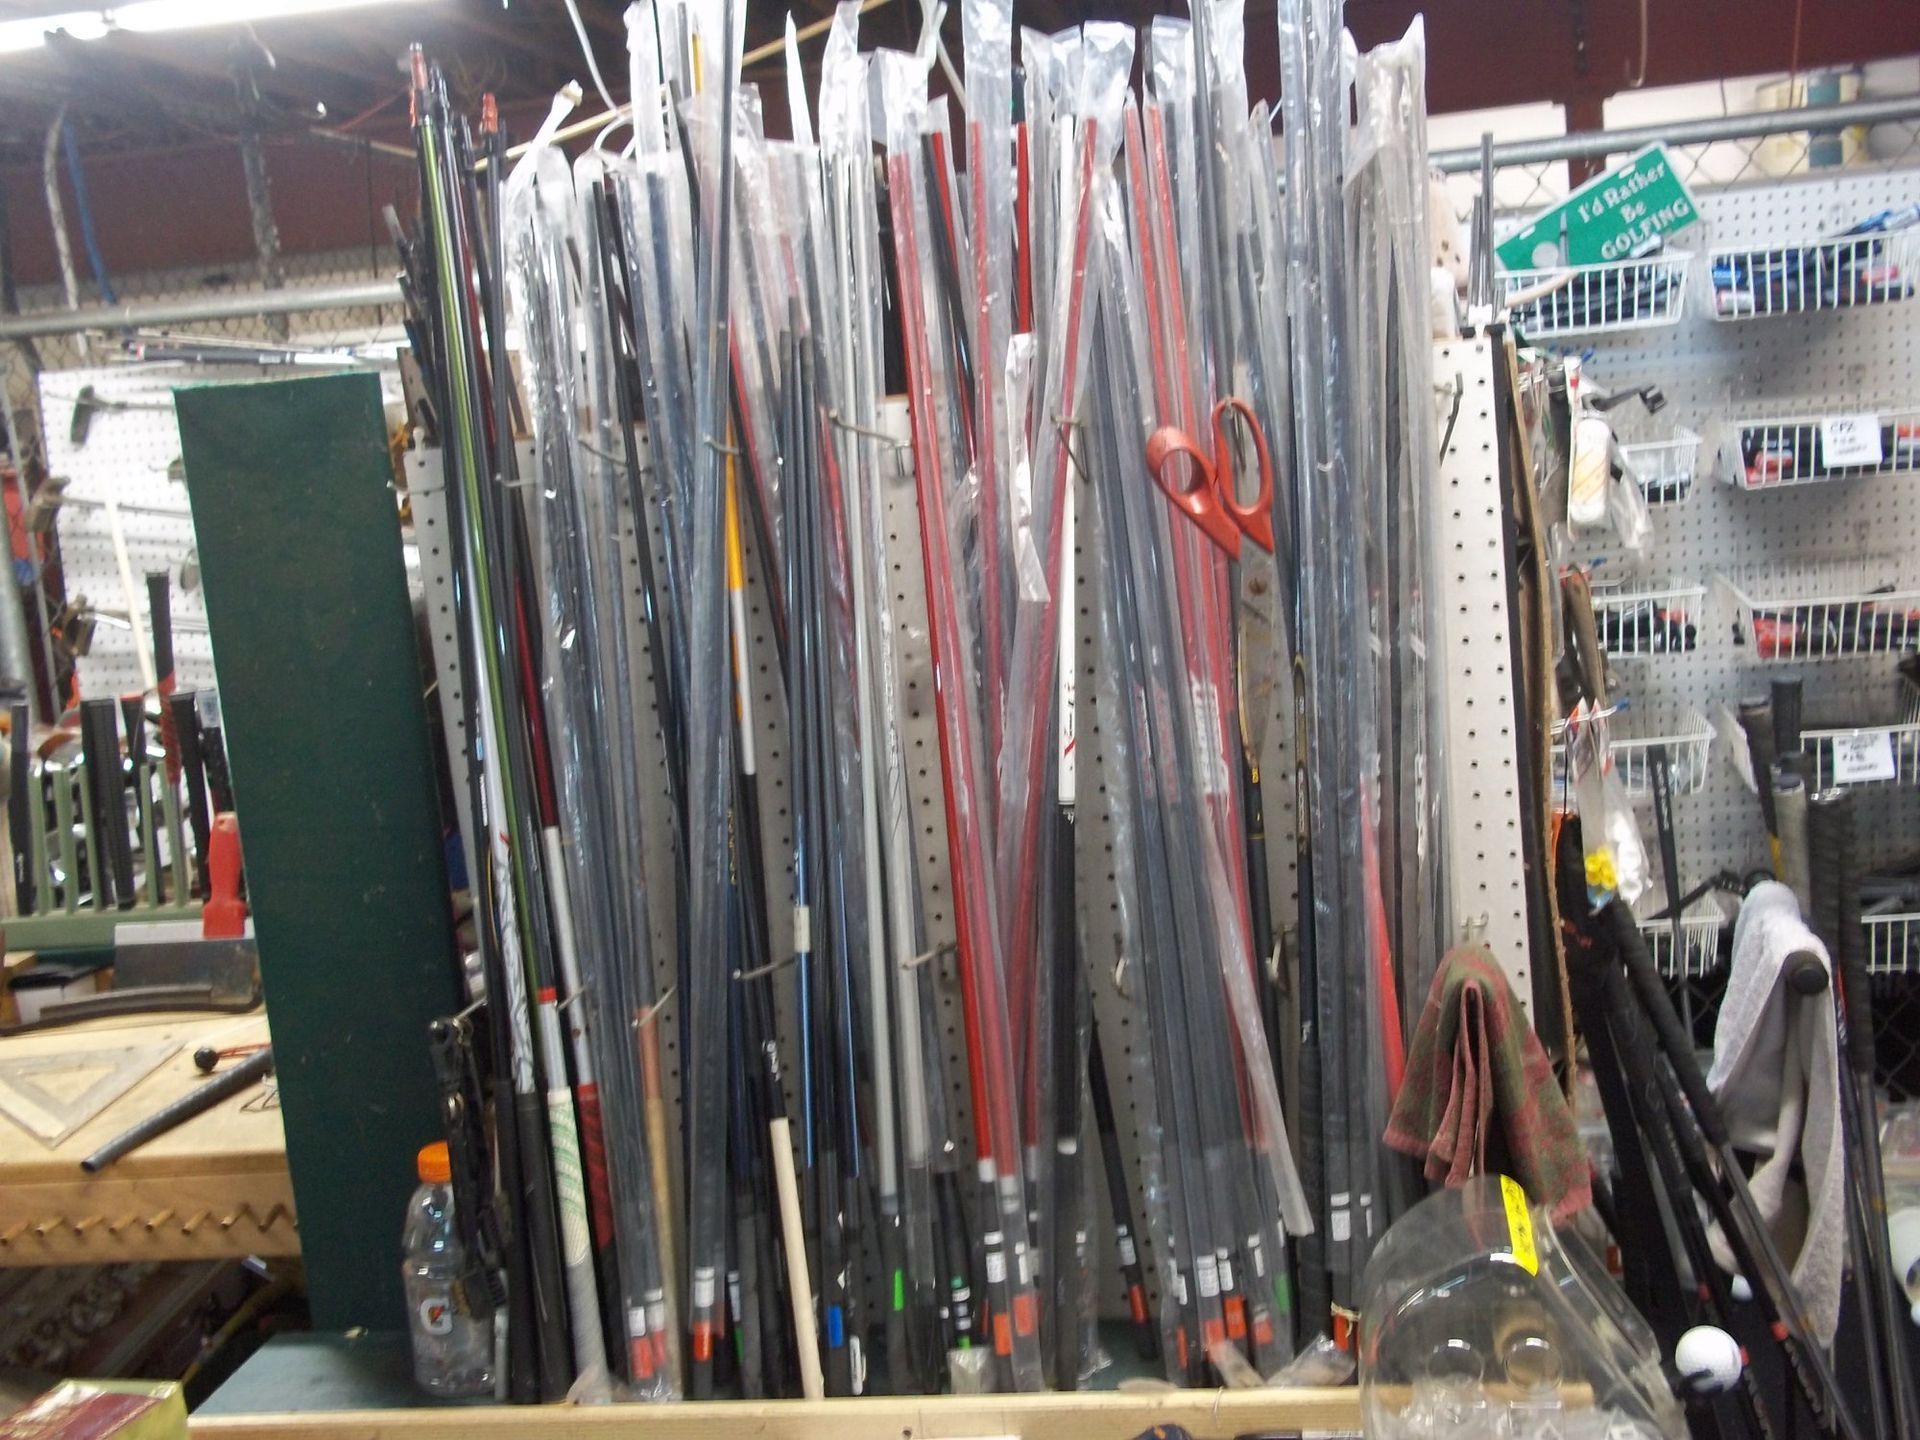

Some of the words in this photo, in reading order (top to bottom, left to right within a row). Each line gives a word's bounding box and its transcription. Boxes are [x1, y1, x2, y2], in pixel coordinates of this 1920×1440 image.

[1577, 196, 1603, 224] I'd
[1603, 161, 1666, 206] Rather
[1621, 200, 1647, 224] Be
[1601, 198, 1690, 260] GOLFING
[420, 1297, 453, 1335] G
